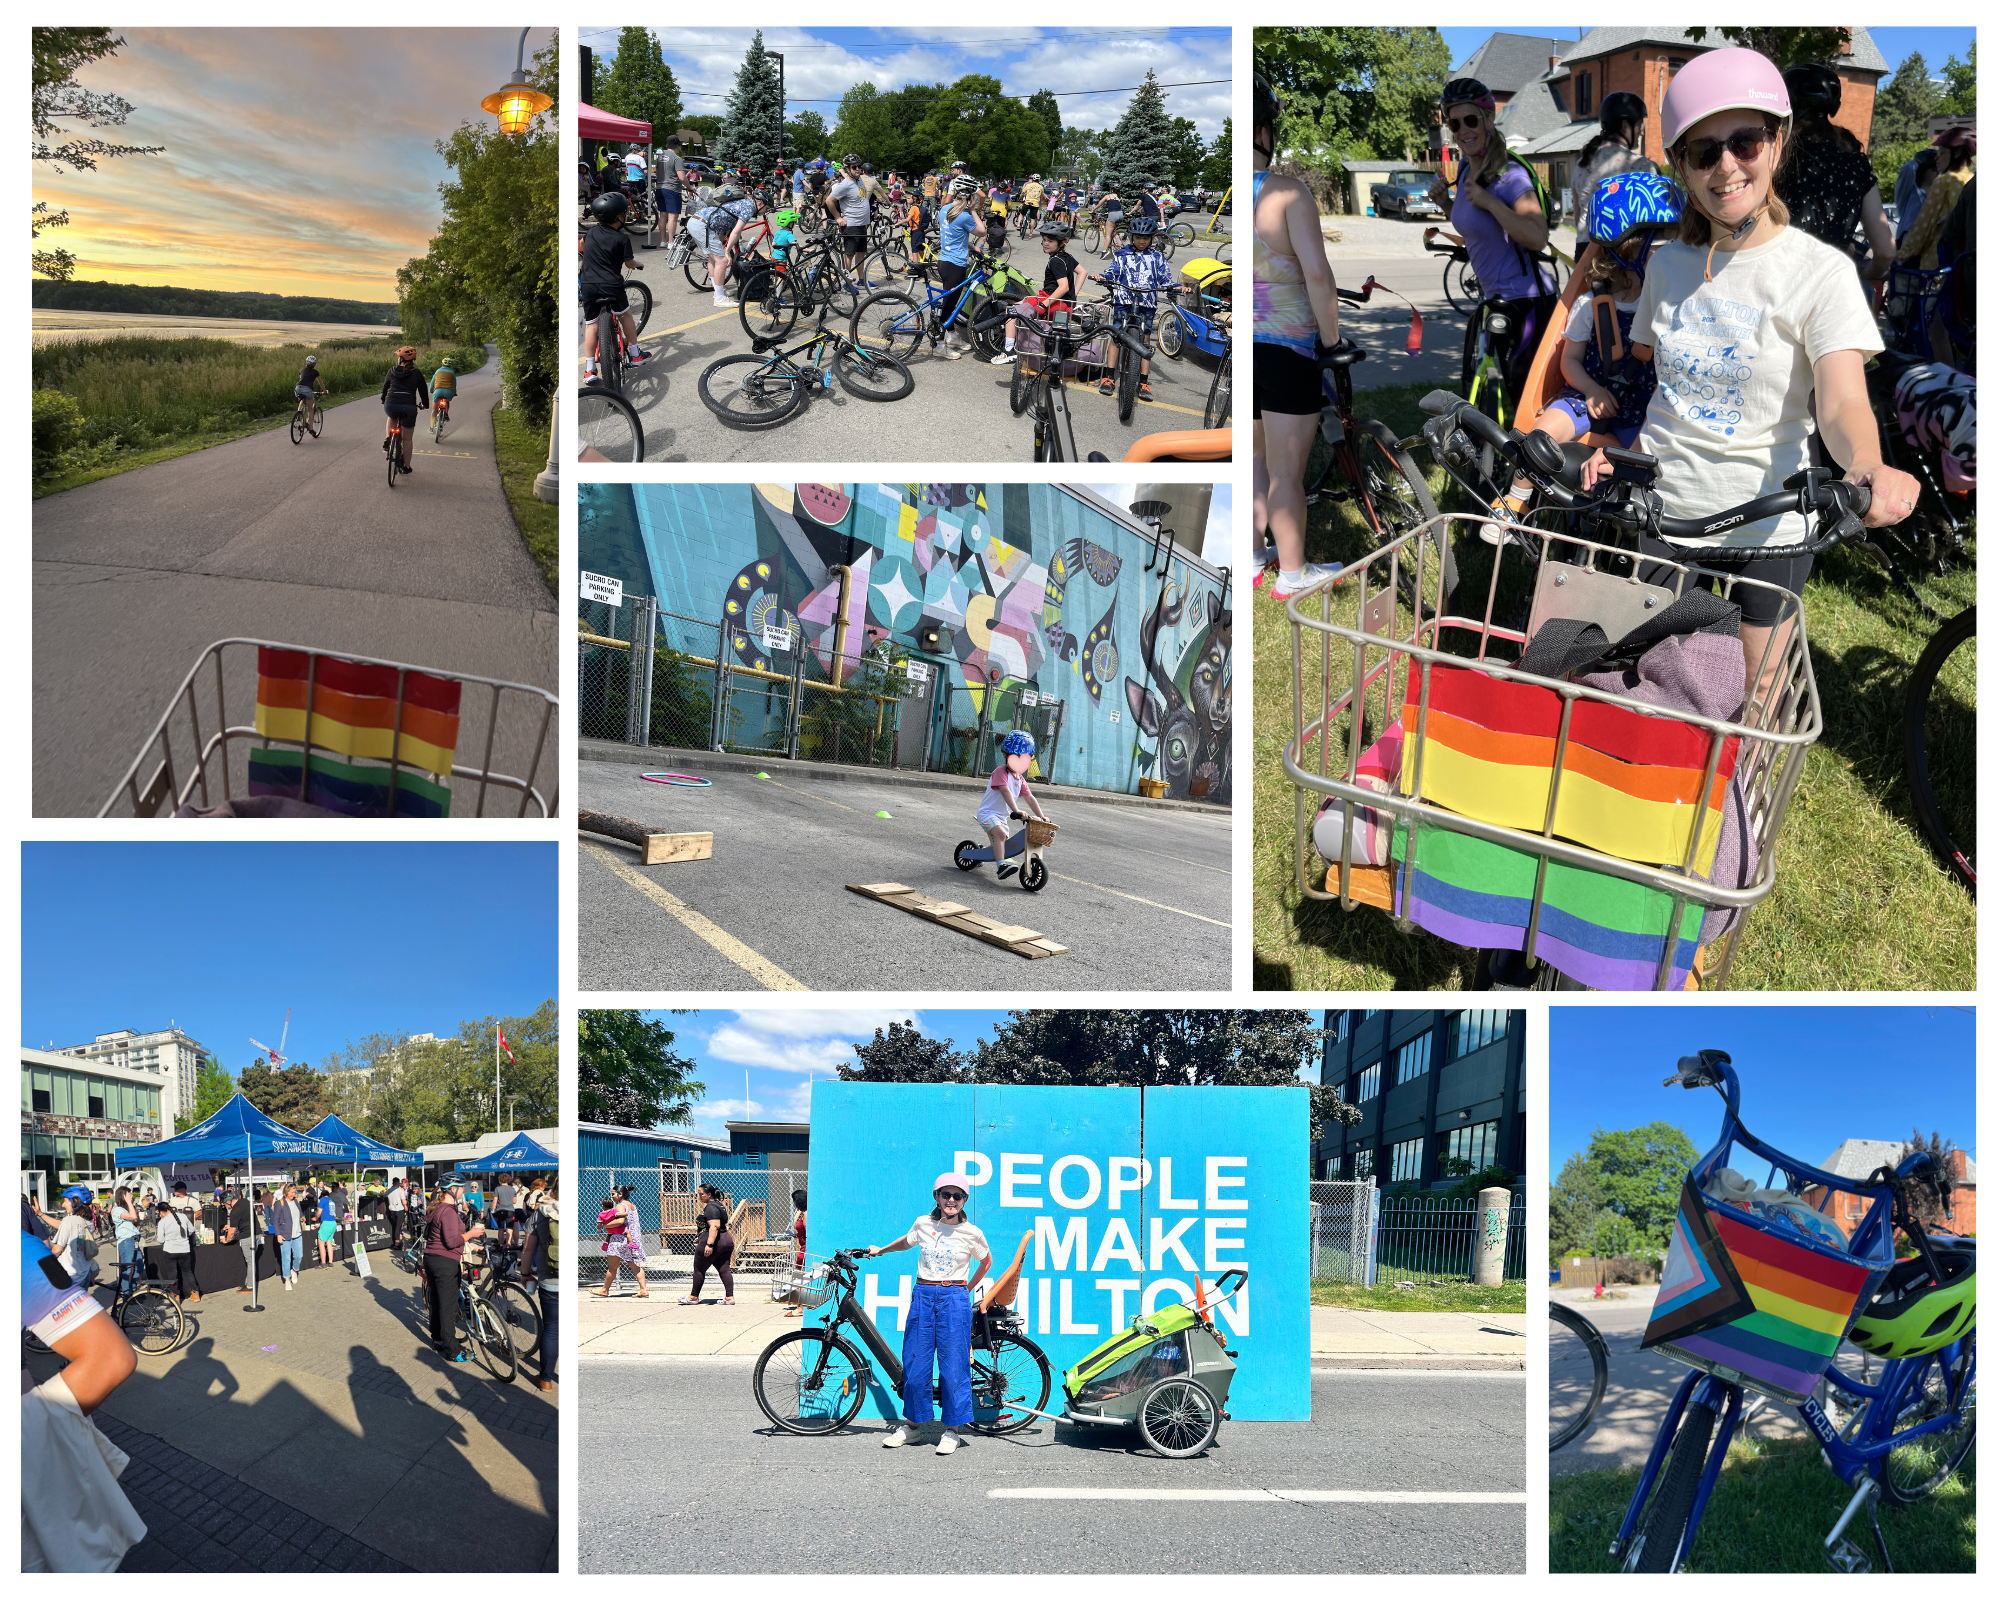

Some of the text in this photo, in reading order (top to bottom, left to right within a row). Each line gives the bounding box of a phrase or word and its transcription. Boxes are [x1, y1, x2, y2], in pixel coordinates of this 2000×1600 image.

[1748, 88, 1778, 101] thousand
[1699, 322, 1753, 340] MONTH
[585, 573, 619, 587] SUCRO CAN
[589, 583, 614, 595] PARKING
[594, 593, 609, 602] ONLY
[272, 1140, 334, 1155] SUSTAINABLE MOBILITY
[163, 1173, 190, 1182] COFFEE
[198, 1173, 211, 1181] TEA
[953, 1150, 1249, 1210] PEOPLE
[1034, 1216, 1249, 1272] MAKE
[52, 1302, 74, 1322] CARRY
[72, 1296, 85, 1307] THE
[863, 1274, 1250, 1336] HMILTON
